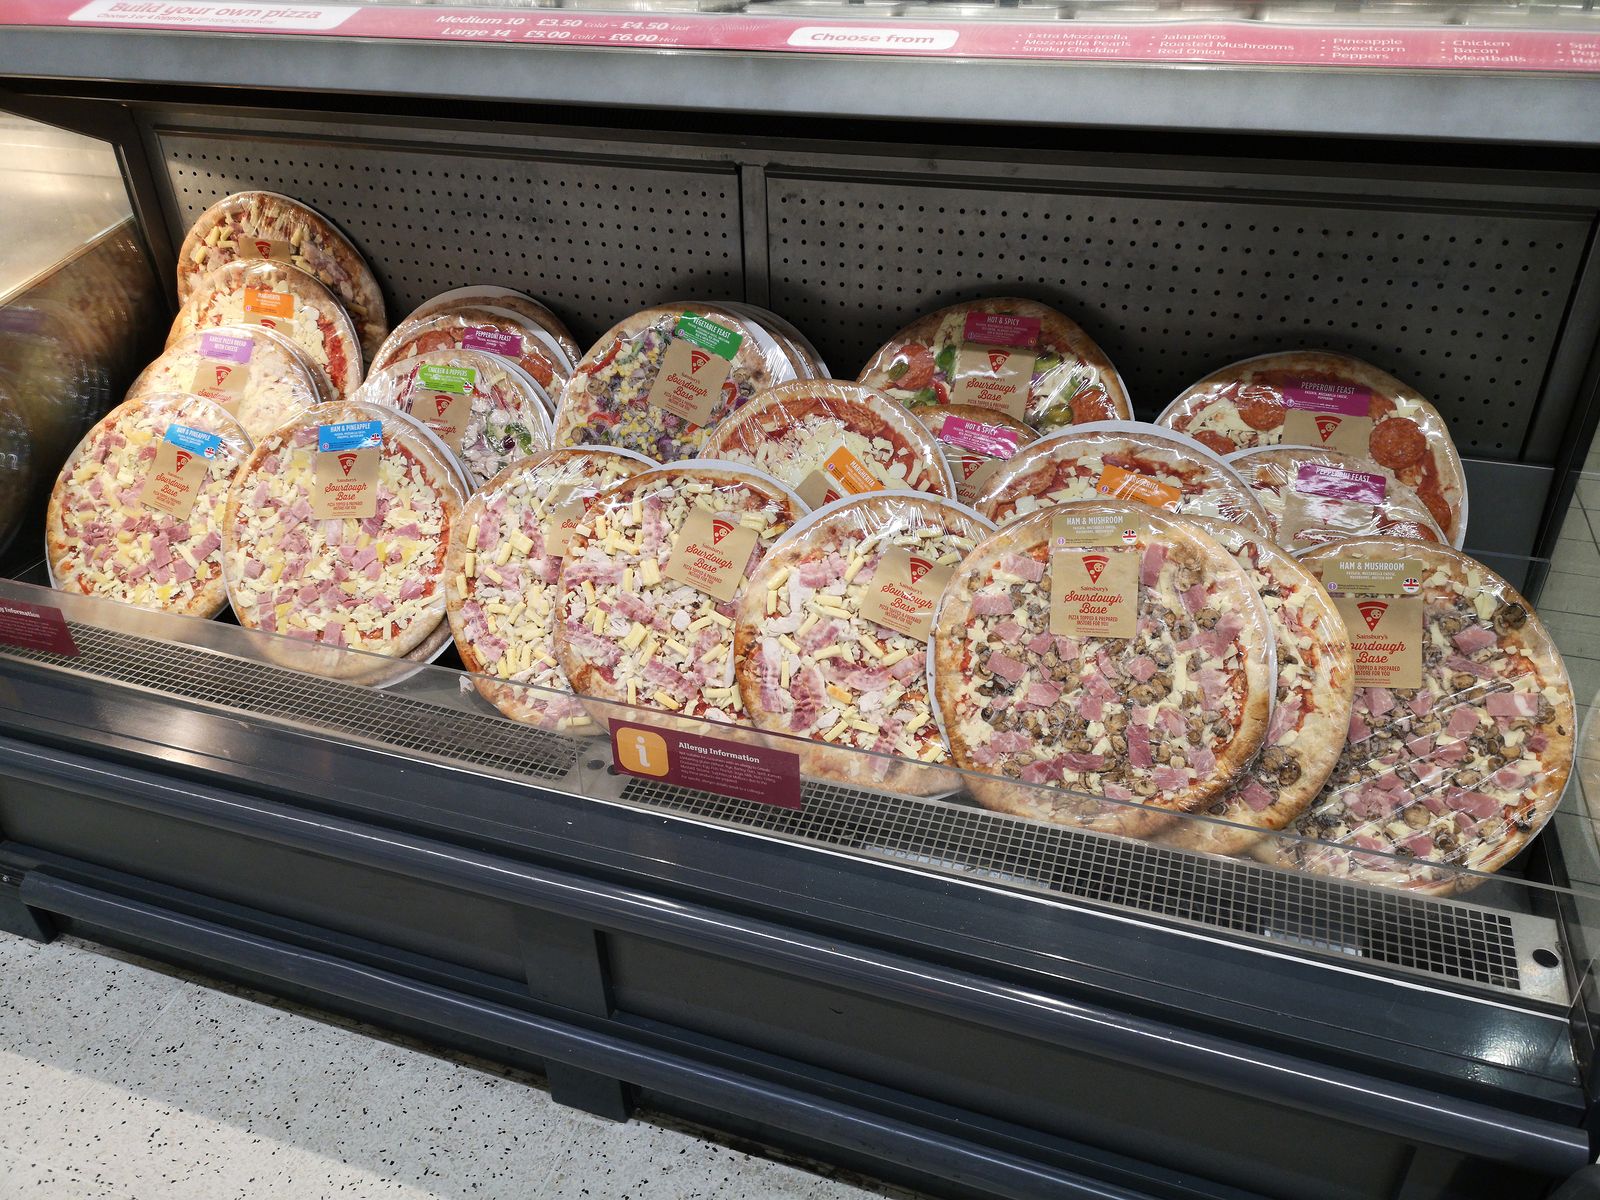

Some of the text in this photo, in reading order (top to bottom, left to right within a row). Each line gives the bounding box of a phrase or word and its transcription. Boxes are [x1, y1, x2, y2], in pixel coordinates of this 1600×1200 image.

[108, 2, 322, 19] Build your own pizza
[436, 15, 503, 25] Medium
[536, 18, 583, 27] £3.50
[620, 21, 669, 31] £4.50
[441, 27, 488, 37] Large
[524, 30, 570, 39] £5.00
[609, 32, 658, 42] £6.00
[810, 32, 935, 44] Choose from
[1159, 40, 1295, 50] Roasted Mushrooms
[1333, 38, 1403, 46] Pineapple
[1452, 39, 1511, 47] Chicken
[1157, 47, 1189, 55] Red
[1332, 52, 1389, 60] Peppers
[1453, 46, 1499, 54] Bacon
[1453, 54, 1527, 62] Meatballs
[693, 317, 717, 333] VEGETABLE
[717, 328, 731, 339] FEAST
[1004, 318, 1020, 326] SPICY
[475, 330, 499, 340] PEPPERONI
[499, 334, 511, 342] FEAST
[666, 373, 708, 397] Sourdough
[966, 378, 1016, 395] Sourdough
[1301, 381, 1356, 395] PEPPERONI FEAST
[673, 385, 694, 401] Base
[978, 389, 1002, 402] Base
[330, 425, 341, 433] HAM
[346, 422, 371, 431] PINEAPPLE
[965, 422, 976, 430] HOT
[982, 426, 998, 435] SPICY
[188, 430, 211, 441] PINEAPPLE
[850, 460, 876, 487] MARGHERITA
[1351, 473, 1370, 483] FEAST
[155, 472, 190, 493] Sourdough
[324, 482, 368, 494] Sourdough
[160, 484, 178, 497] Base
[335, 491, 356, 502] Base
[1066, 515, 1124, 525] HAM & MUSHROOM
[684, 543, 733, 570] Sourdough
[693, 557, 717, 574] Base
[1340, 561, 1405, 571] HAM & MUSHROOM
[880, 582, 933, 609] Sourdough
[1063, 590, 1124, 606] Sourdough
[890, 597, 916, 614] Base
[1079, 602, 1108, 614] Base
[5, 606, 40, 619] Information
[1356, 633, 1389, 641] Sainsbury's
[1350, 640, 1407, 655] urdough
[1355, 651, 1389, 663] Base
[679, 741, 760, 764] Allergy Information
